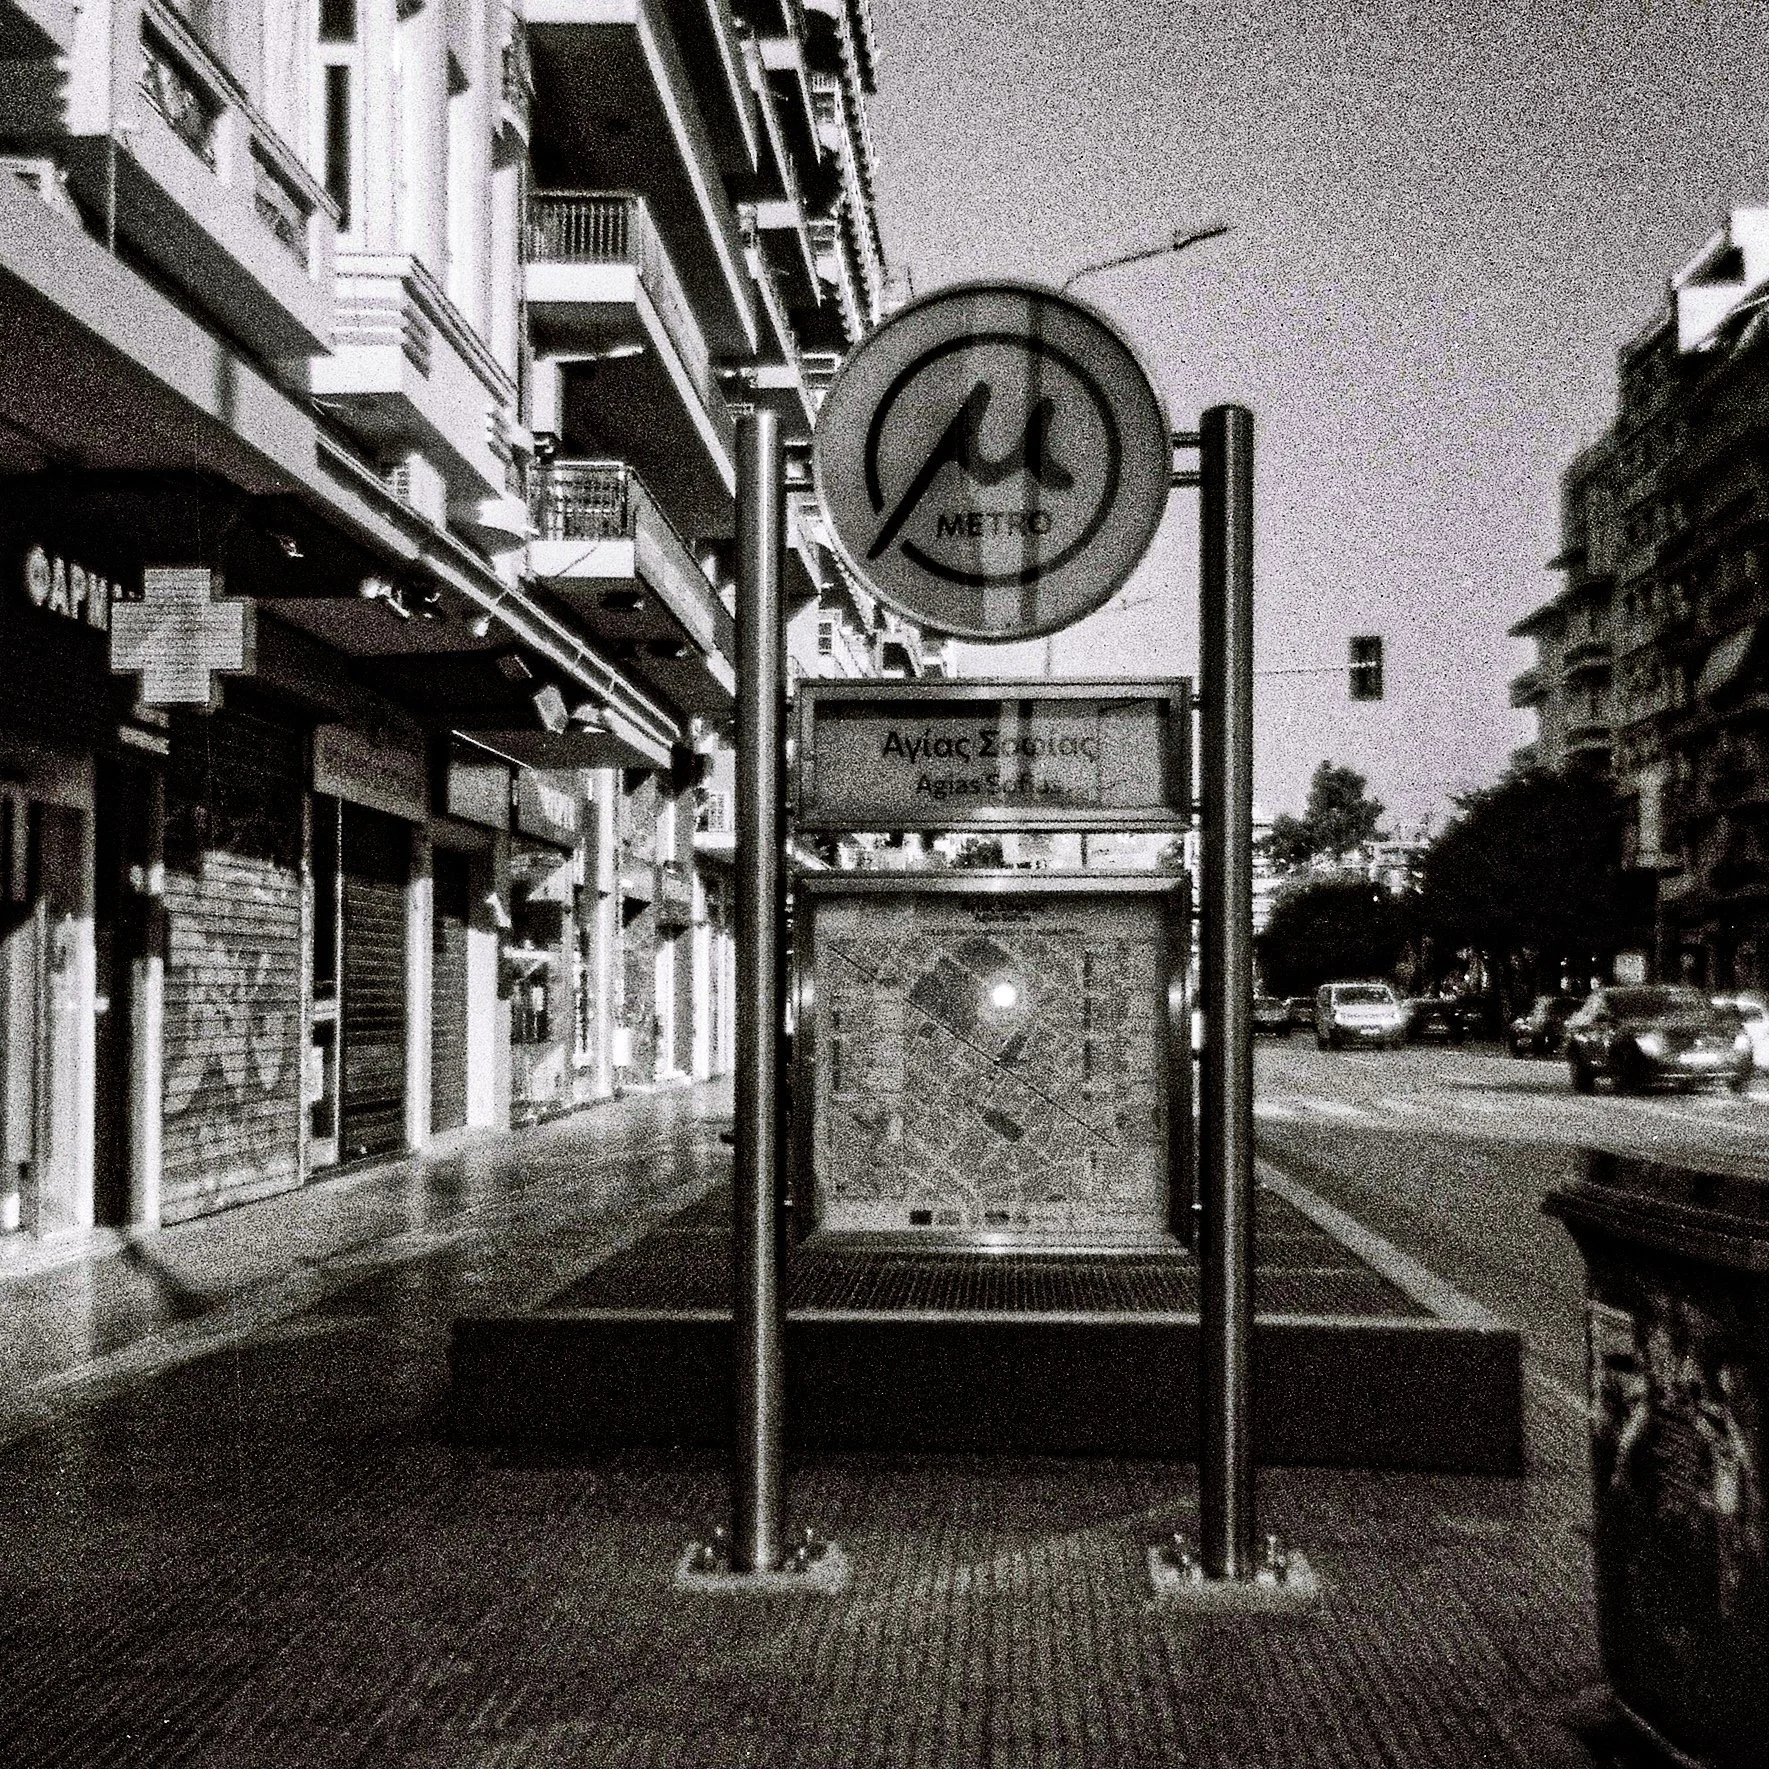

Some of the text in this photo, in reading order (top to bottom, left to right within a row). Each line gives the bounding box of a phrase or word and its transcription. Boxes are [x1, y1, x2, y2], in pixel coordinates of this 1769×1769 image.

[937, 510, 1053, 537] METRO
[884, 728, 971, 764] Αγίας
[916, 773, 981, 800] Agias
